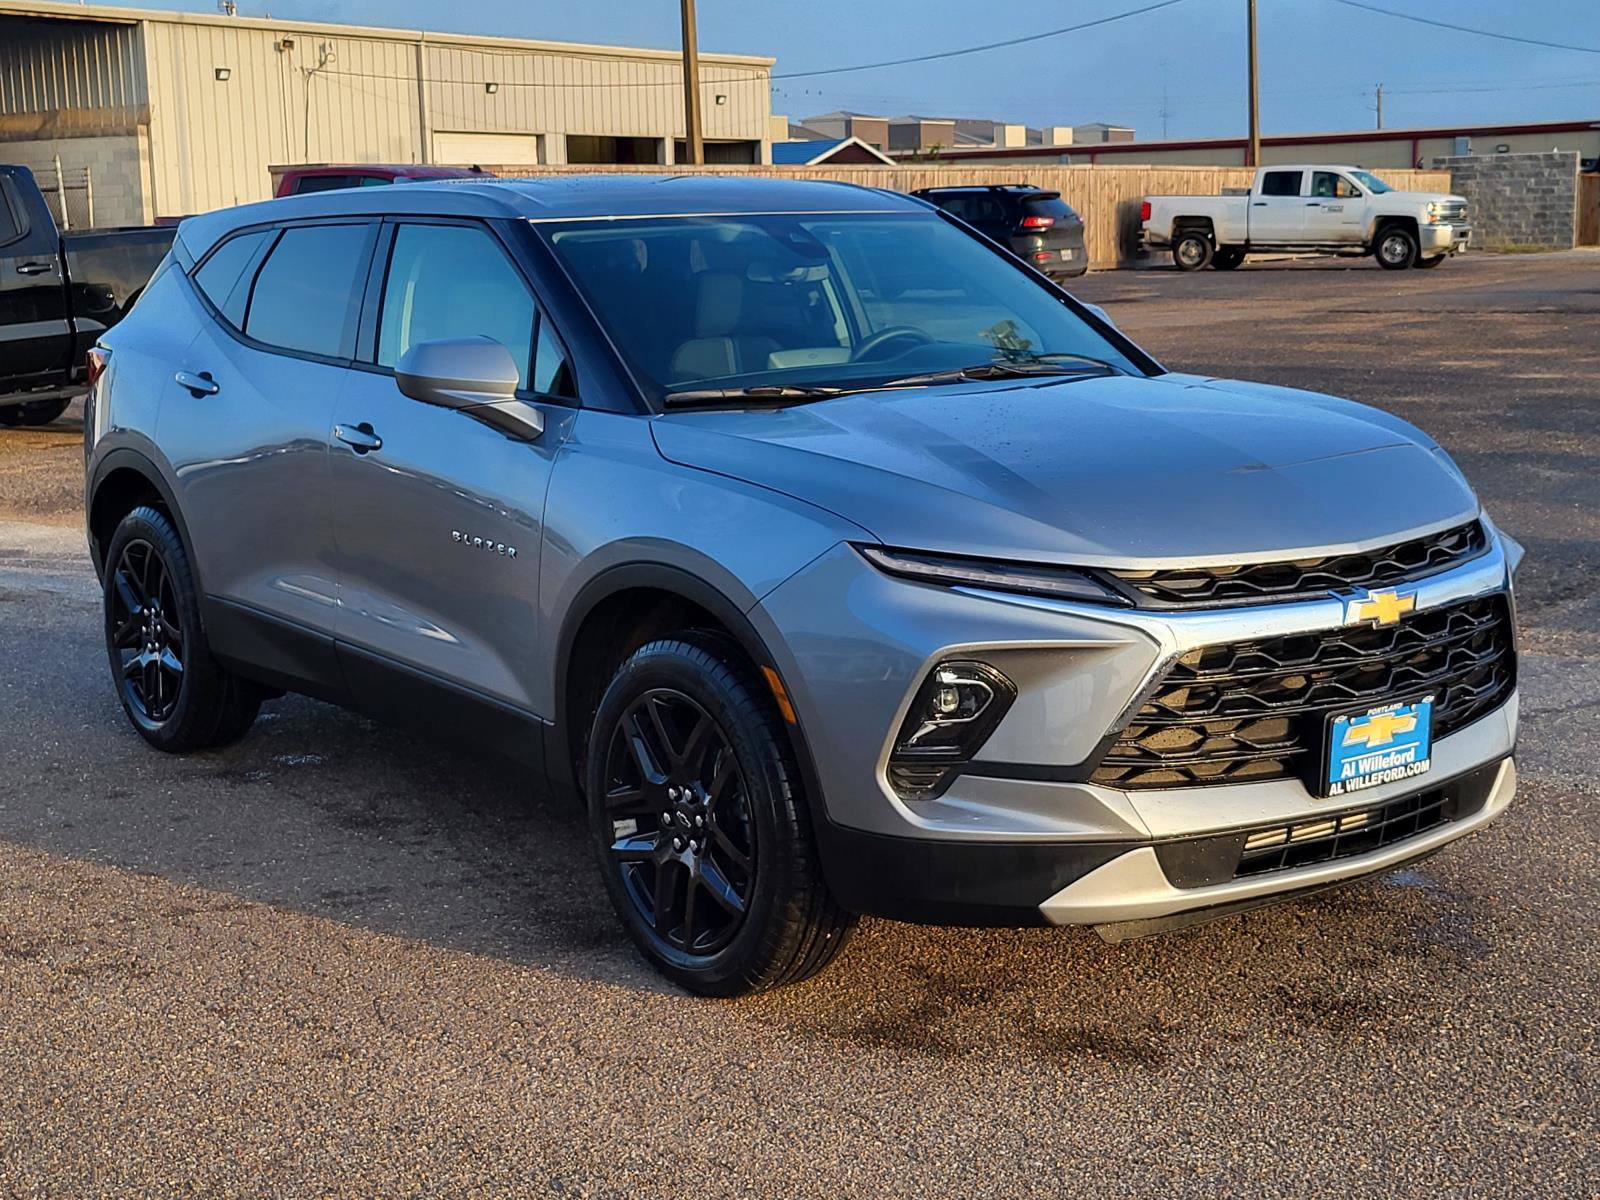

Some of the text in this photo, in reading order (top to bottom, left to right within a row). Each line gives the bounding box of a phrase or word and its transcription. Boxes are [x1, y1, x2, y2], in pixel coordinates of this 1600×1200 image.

[452, 530, 517, 560] BLAZER
[1366, 702, 1404, 717] PORTLAND
[1341, 747, 1416, 779] Al Willeford
[1345, 759, 1430, 792] WILLEFORD.COM
